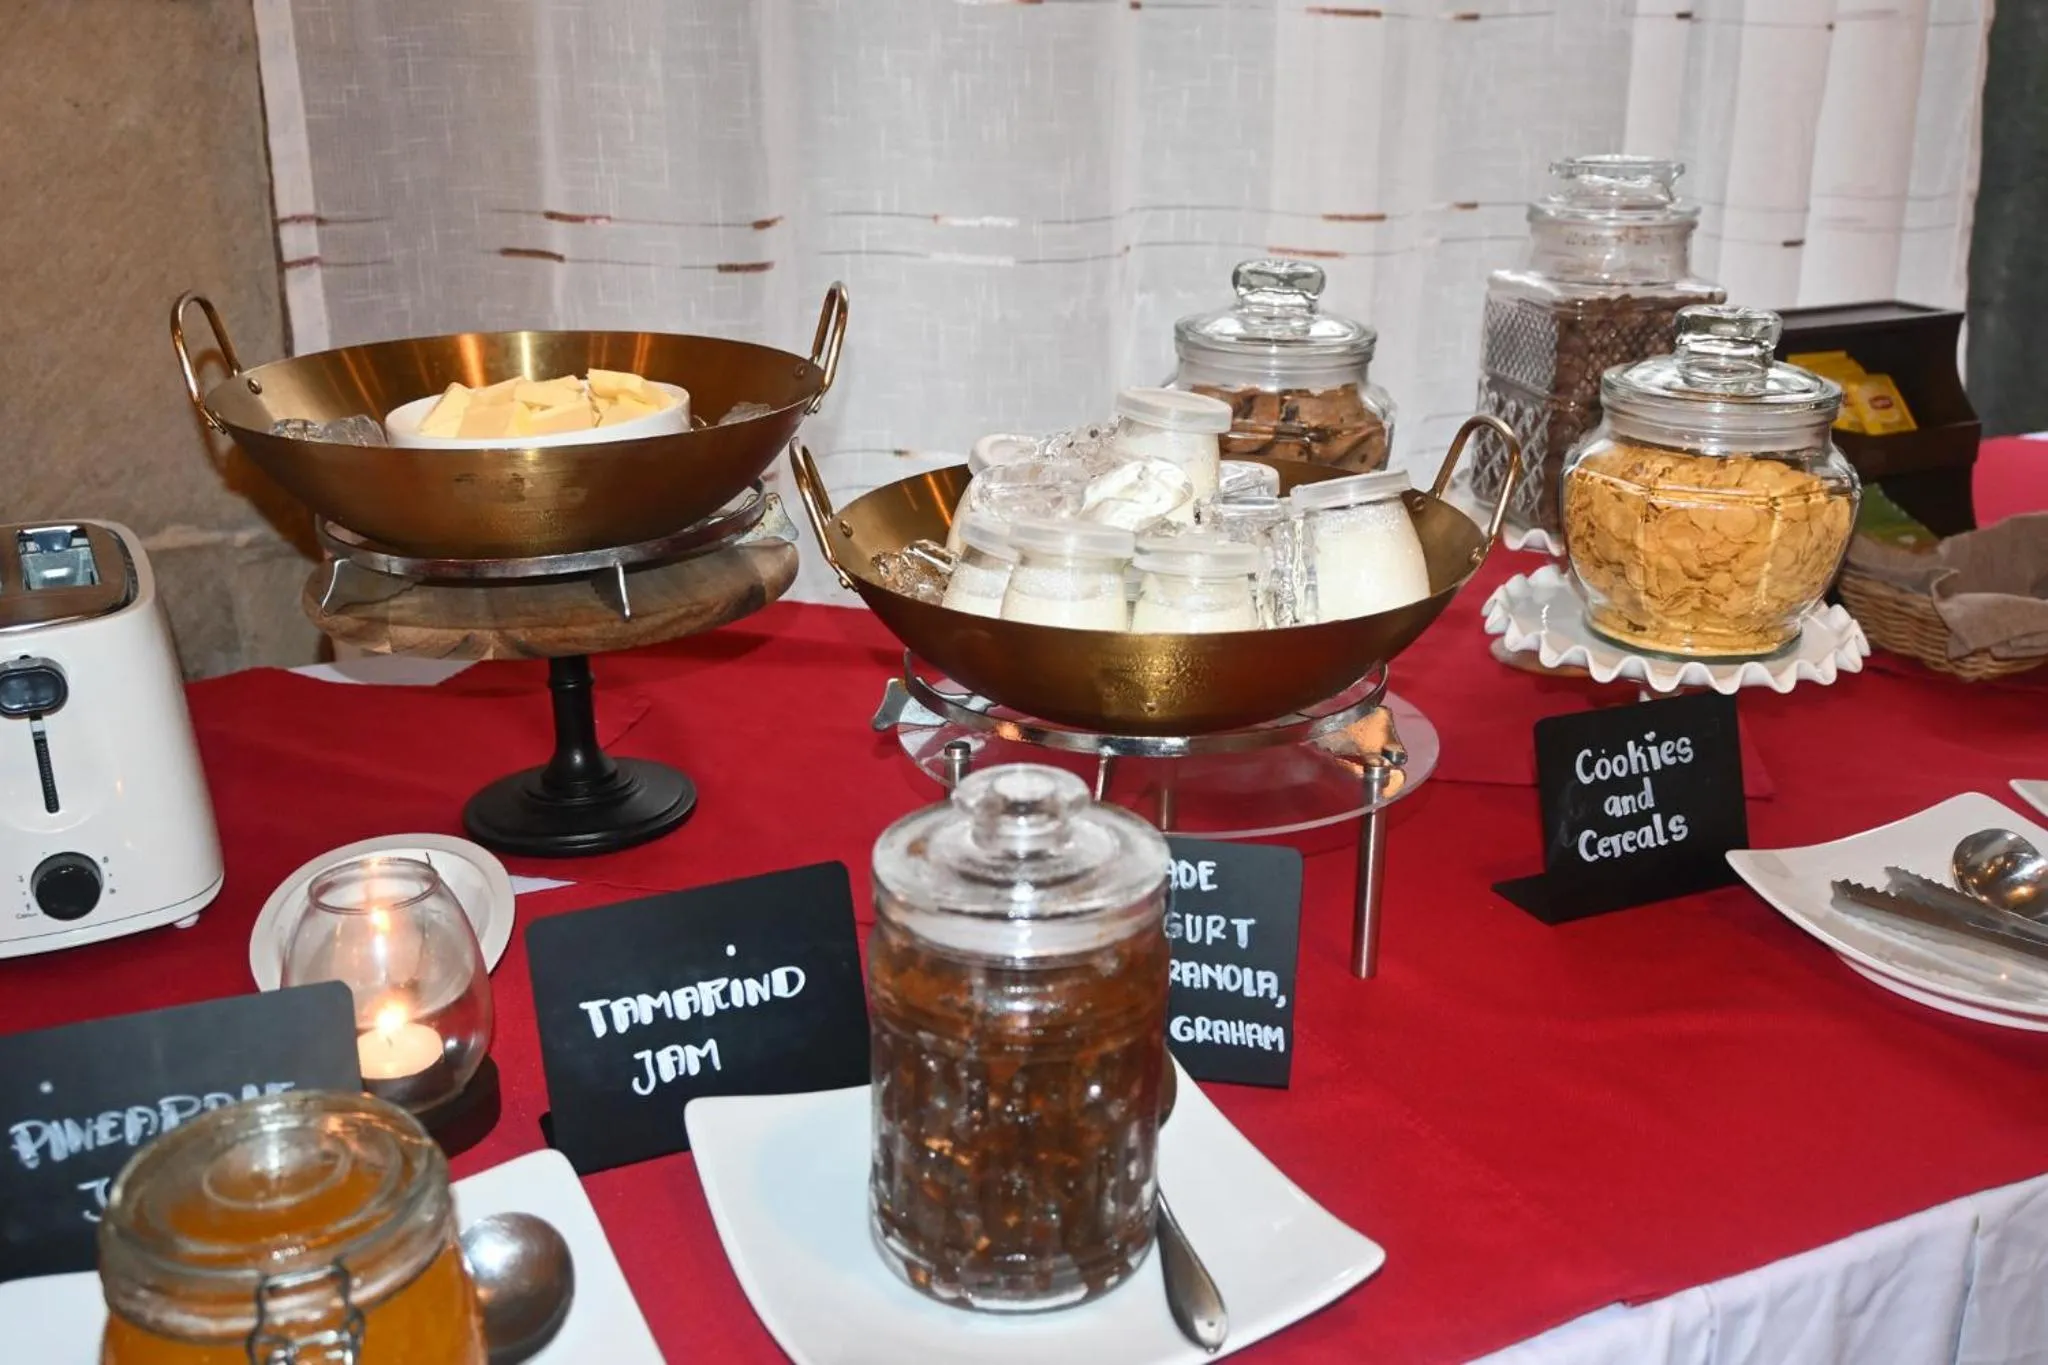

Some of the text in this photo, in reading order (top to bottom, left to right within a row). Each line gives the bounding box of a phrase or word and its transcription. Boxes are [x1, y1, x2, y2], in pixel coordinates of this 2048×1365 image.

[1575, 731, 1694, 784] Cookies
[1604, 777, 1655, 817] and
[1578, 813, 1689, 862] Cereals
[1165, 858, 1218, 891] ADE
[1163, 911, 1257, 949] GURT
[579, 944, 806, 1038] TAMARIND
[1168, 958, 1287, 1009] RANOLA,
[1169, 1015, 1286, 1053] GRAHAM
[632, 1038, 722, 1095] JAM
